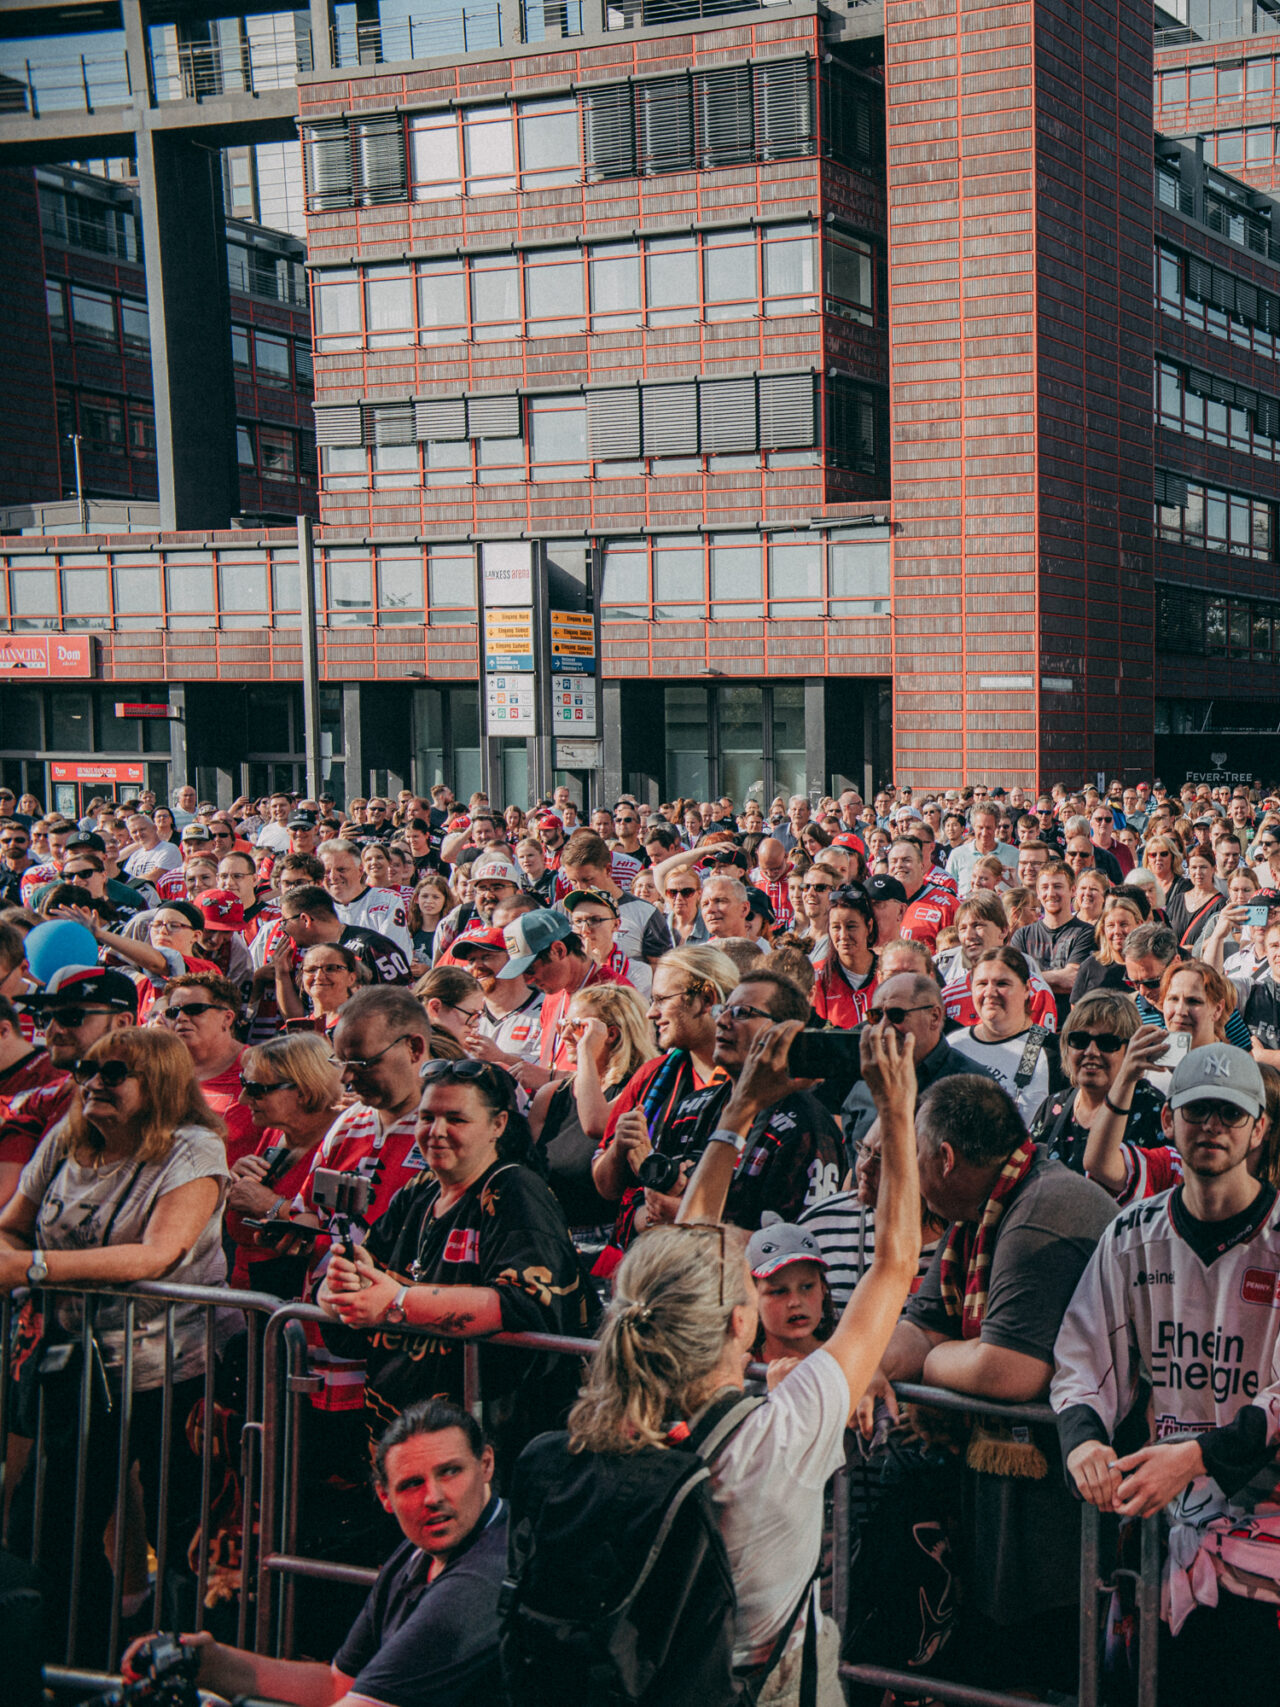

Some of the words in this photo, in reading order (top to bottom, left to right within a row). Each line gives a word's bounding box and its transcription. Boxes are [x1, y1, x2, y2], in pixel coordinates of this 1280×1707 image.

[485, 569, 510, 580] LANXESS
[512, 569, 529, 579] arena
[58, 646, 80, 660] Dom
[478, 865, 507, 877] CGN
[617, 860, 637, 868] HIT
[345, 938, 365, 951] HIT
[375, 953, 409, 981] 50
[677, 1091, 716, 1116] HIT
[804, 1157, 840, 1206] 36
[1114, 1204, 1164, 1237] HIT
[1246, 1281, 1271, 1292] PENNY
[1158, 1320, 1244, 1363] Rhein
[1152, 1351, 1260, 1404] Energie
